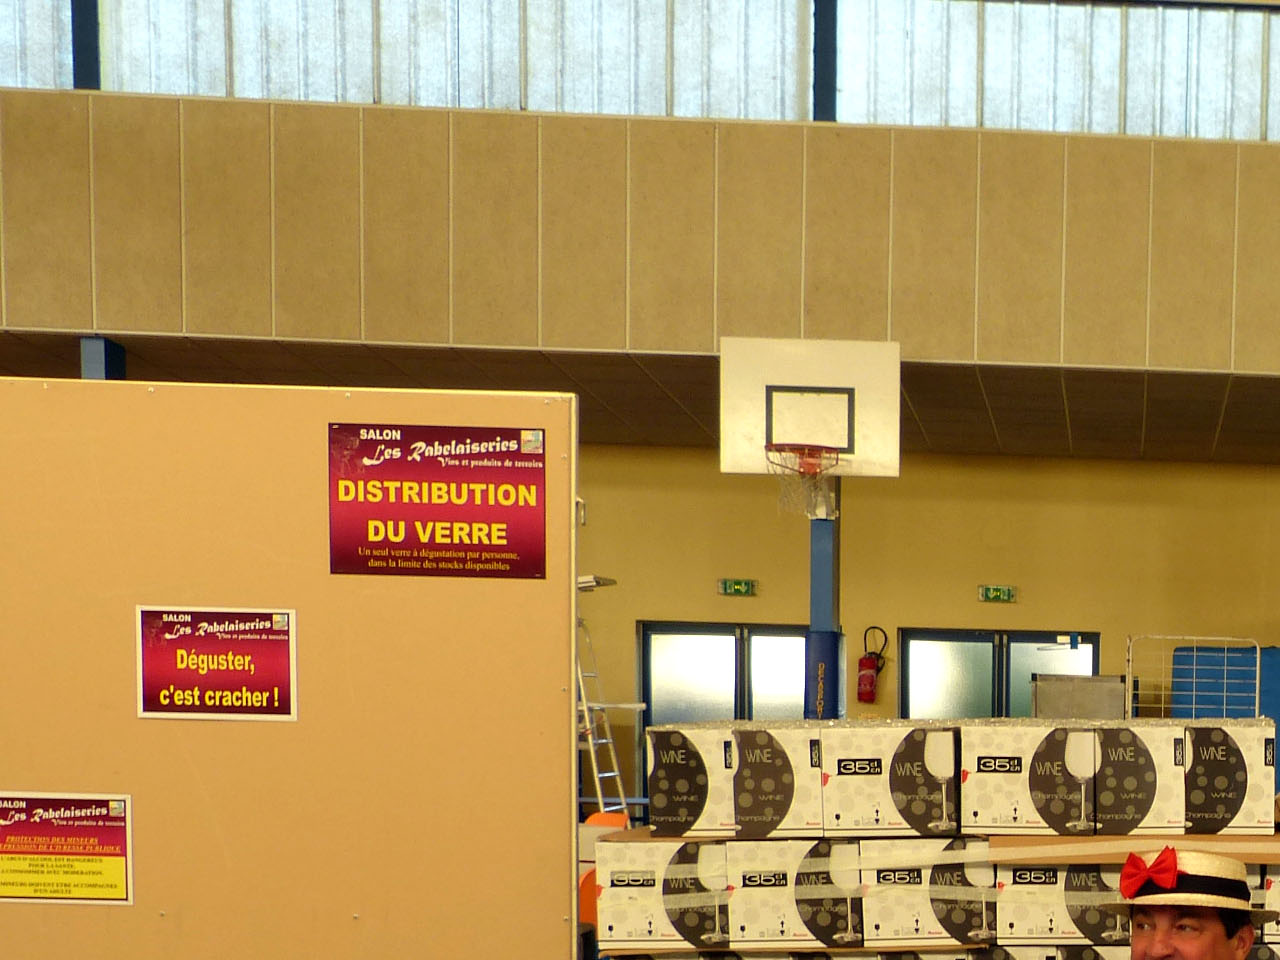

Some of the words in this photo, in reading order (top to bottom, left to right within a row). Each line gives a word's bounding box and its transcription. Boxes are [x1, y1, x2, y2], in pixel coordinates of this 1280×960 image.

[360, 429, 401, 441] SALON
[362, 444, 401, 466] Les
[407, 436, 518, 462] Rabelaiseries
[338, 479, 537, 507] DISTRIBUTION
[367, 519, 405, 542] DU
[414, 521, 507, 546] VERRE
[358, 547, 371, 556] Un
[373, 548, 389, 556] seul
[419, 548, 465, 560] dégustation
[466, 552, 480, 561] par
[368, 559, 387, 568] dans
[388, 559, 396, 568] la
[398, 559, 421, 568] limite
[423, 560, 437, 569] des
[438, 561, 464, 569] stocks
[465, 561, 510, 571] disponibles
[162, 613, 191, 622] SALON
[164, 624, 192, 640] Les
[194, 618, 271, 636] Rabelaiseries
[176, 649, 255, 675] Déguster,
[159, 685, 200, 706] c'est
[204, 686, 270, 707] cracher
[273, 687, 279, 707] !
[660, 749, 687, 764] WINE
[746, 749, 773, 763] WINE
[1108, 747, 1135, 762] WINE
[1200, 746, 1227, 761] WINE
[896, 762, 923, 777] WINE
[1036, 761, 1063, 776] WINE
[30, 805, 108, 823] Rabelaiseries
[669, 878, 695, 889] WINE
[800, 873, 827, 886] WINE
[935, 872, 962, 886] WINE
[1070, 872, 1097, 887] WINE
